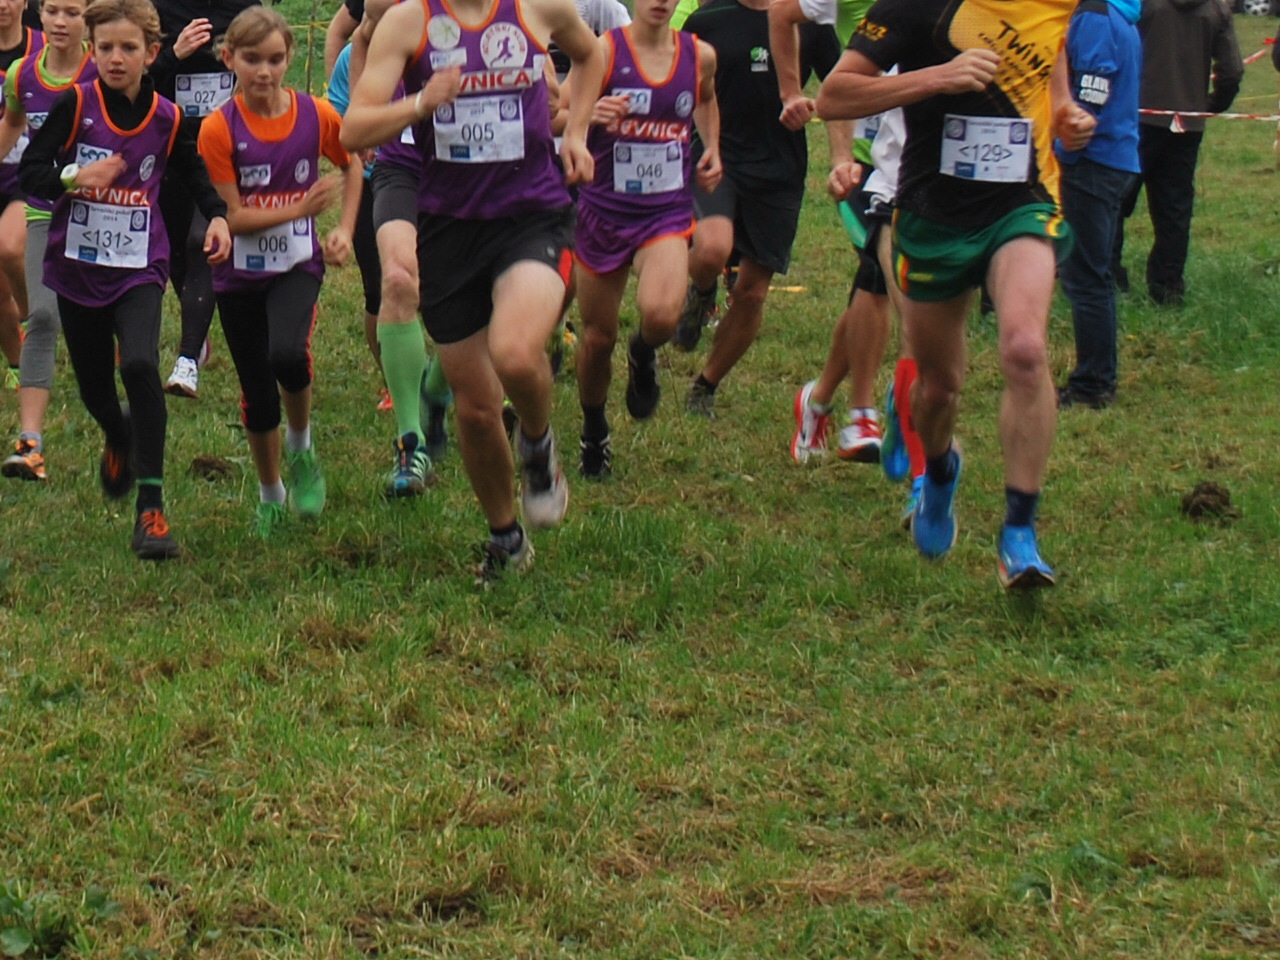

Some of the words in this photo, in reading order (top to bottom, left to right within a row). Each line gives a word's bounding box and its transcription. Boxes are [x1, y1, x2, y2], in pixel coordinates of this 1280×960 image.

[194, 91, 216, 104] 027
[461, 123, 494, 142] 005
[959, 143, 1013, 163] <129>
[636, 163, 663, 179] 046
[82, 228, 133, 249] <131>
[258, 235, 288, 253] 006
